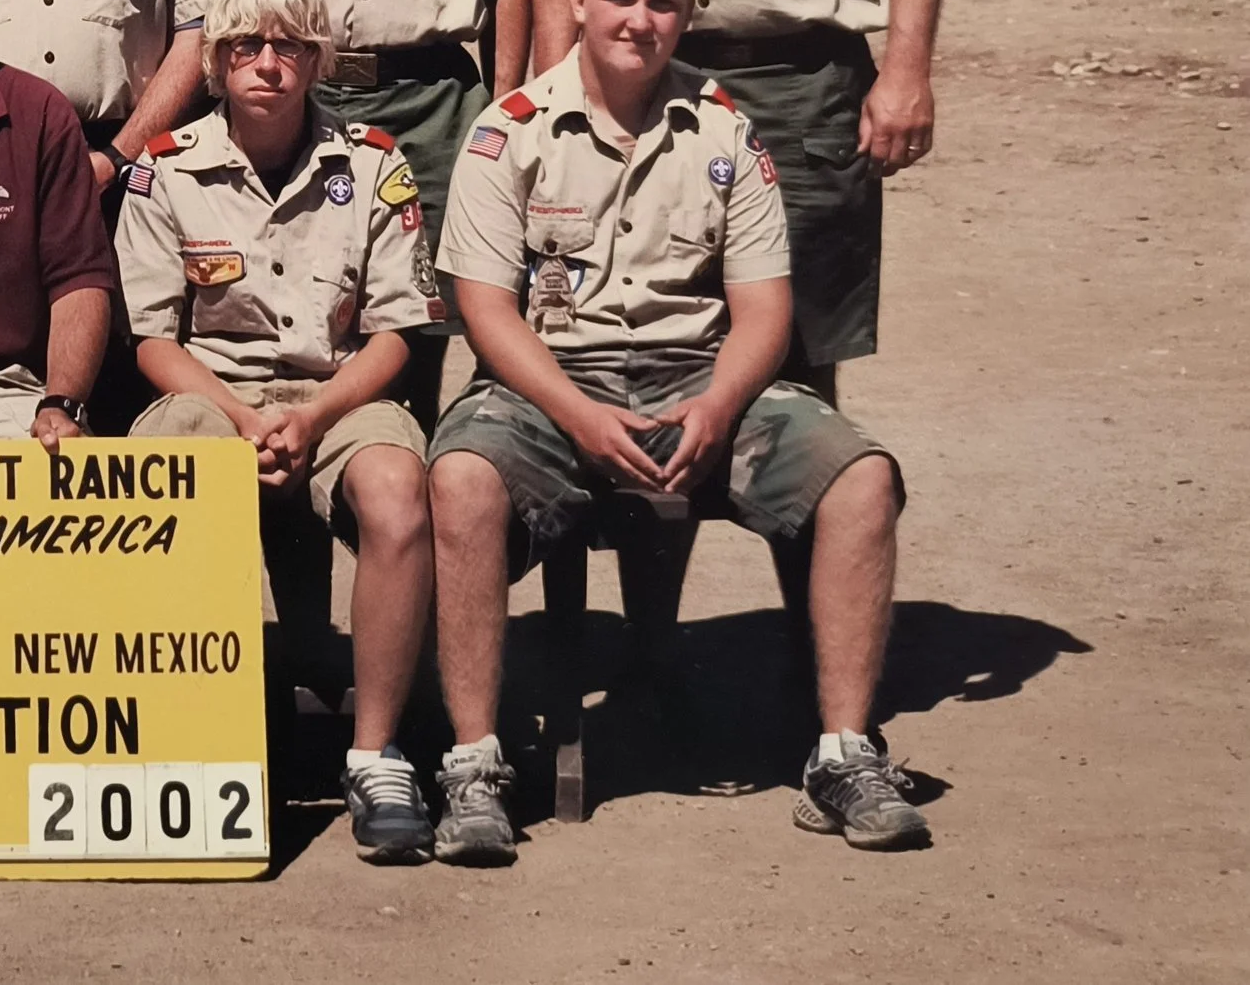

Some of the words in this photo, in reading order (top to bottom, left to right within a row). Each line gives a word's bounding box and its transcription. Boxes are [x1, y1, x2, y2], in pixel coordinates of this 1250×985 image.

[49, 454, 195, 499] RANCH
[15, 633, 97, 674] NEW
[116, 631, 240, 674] MEXICO
[43, 780, 253, 842] 2002
